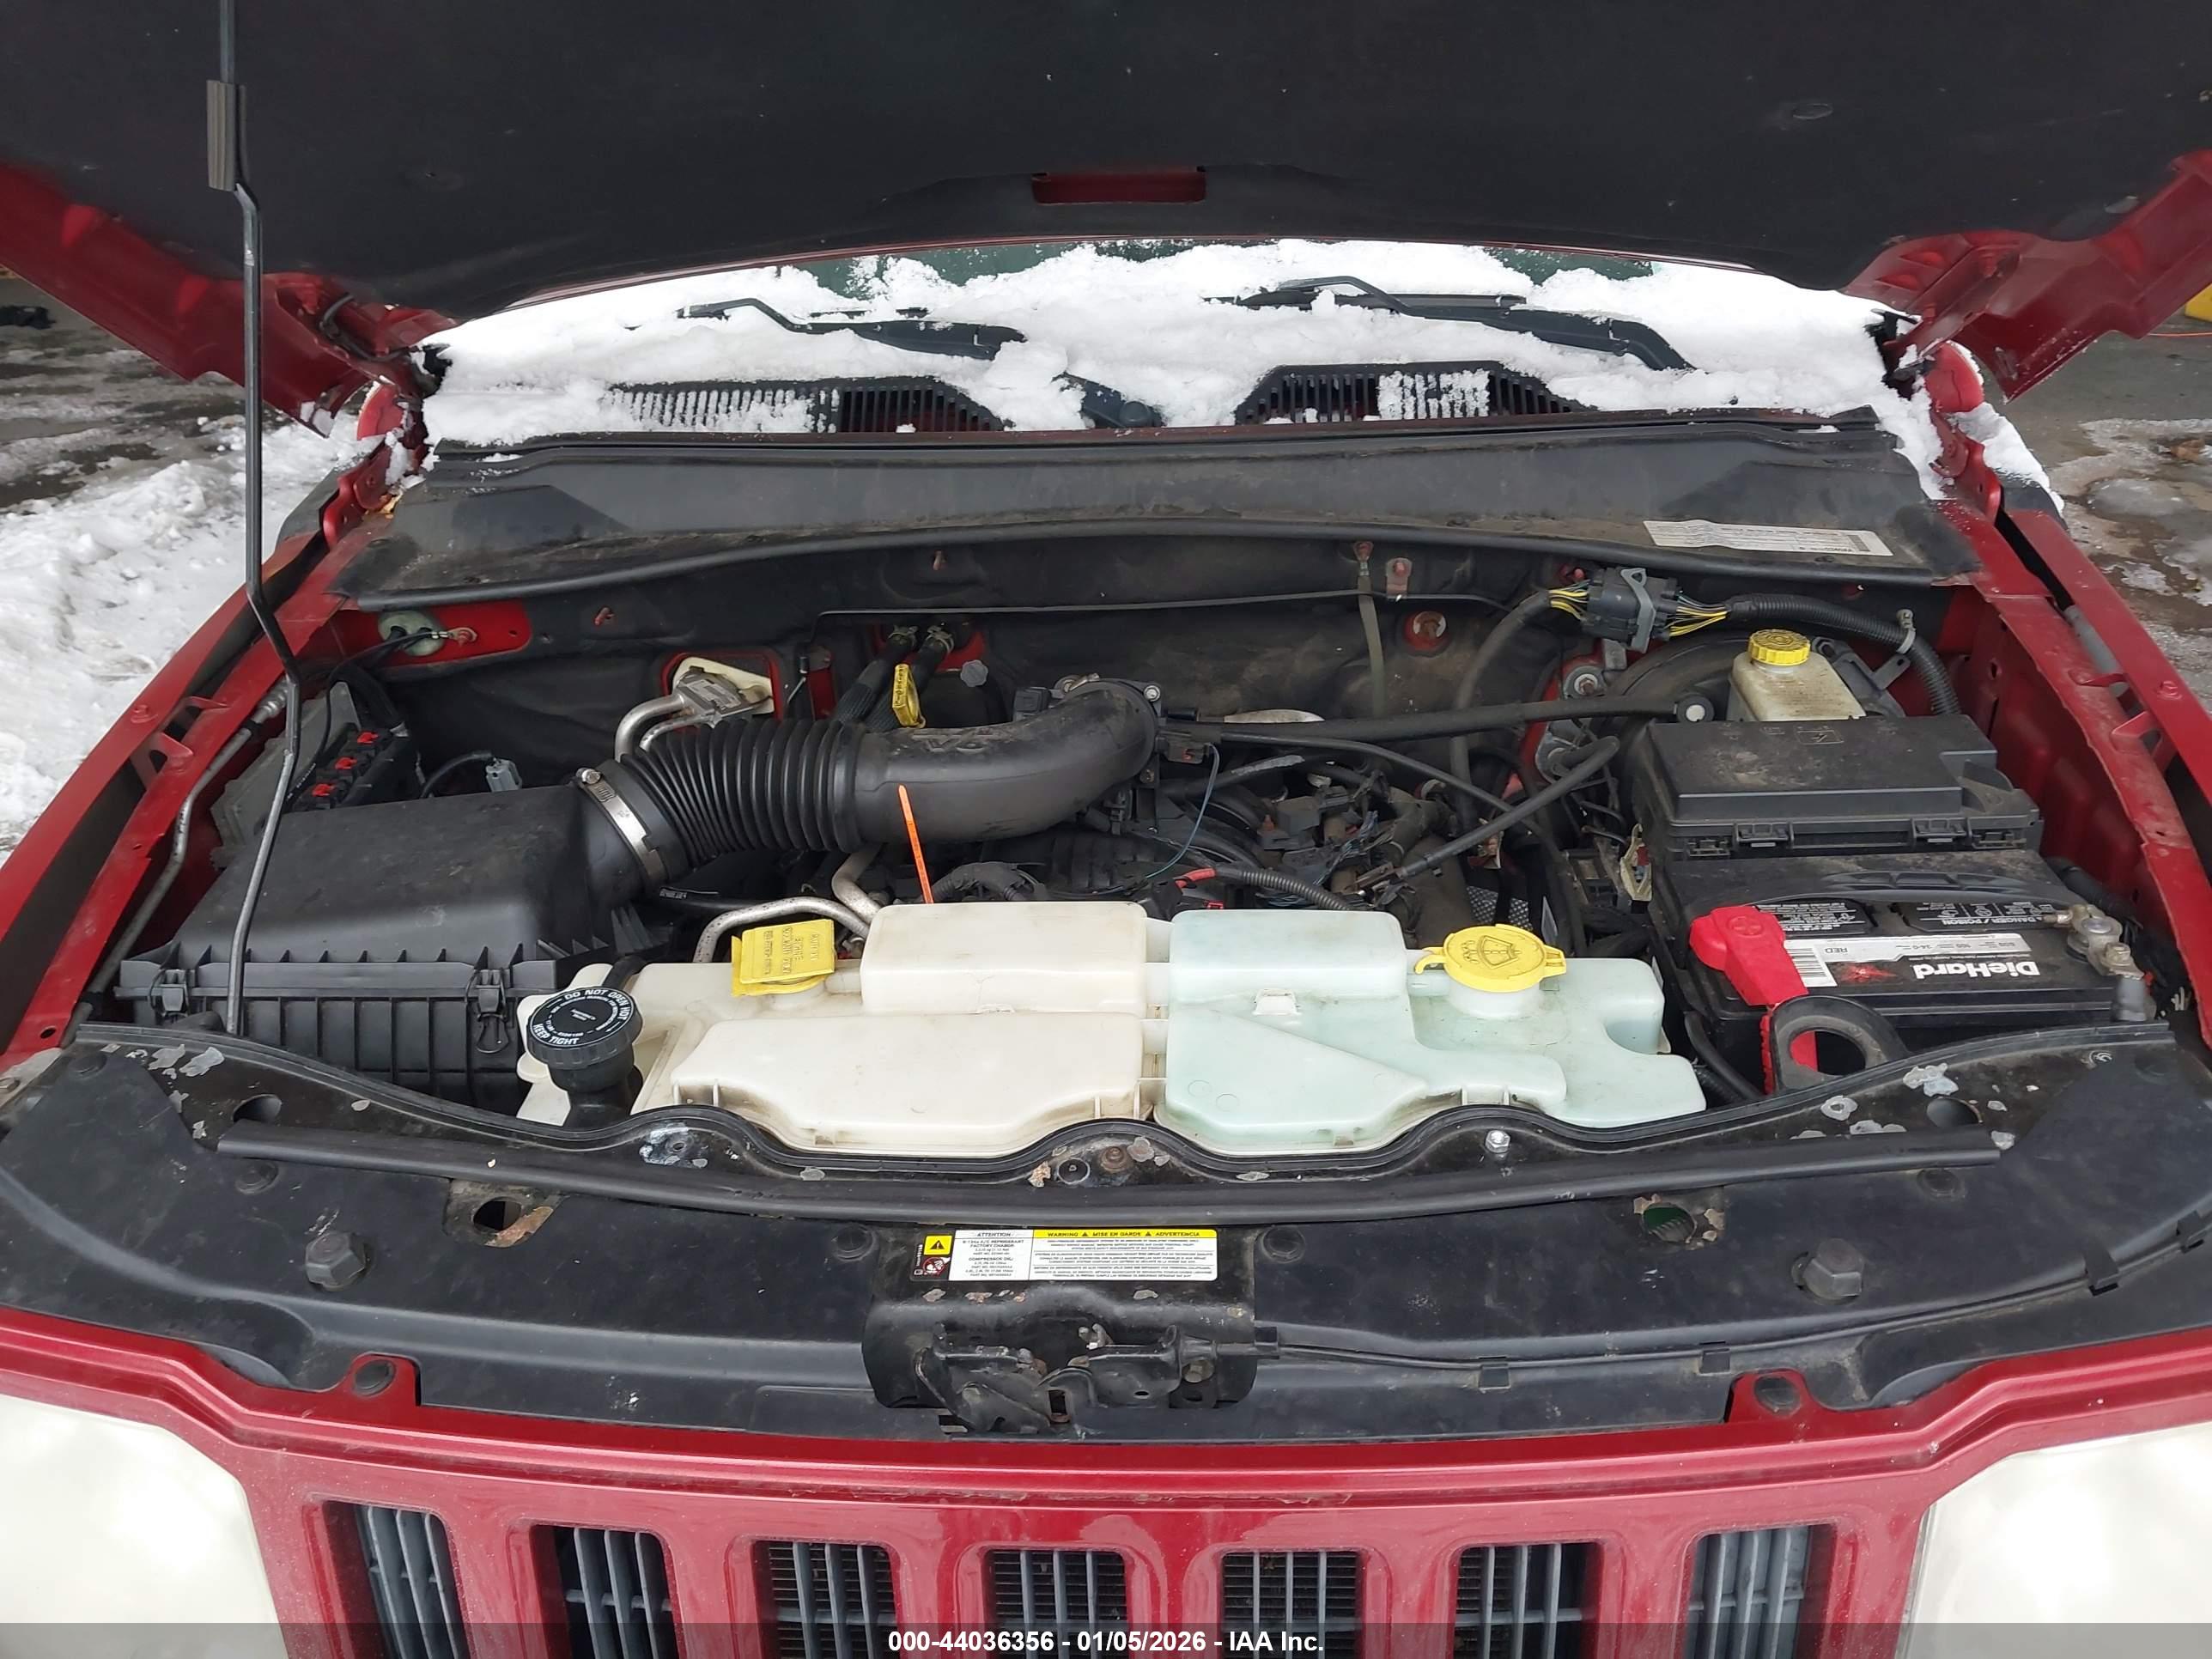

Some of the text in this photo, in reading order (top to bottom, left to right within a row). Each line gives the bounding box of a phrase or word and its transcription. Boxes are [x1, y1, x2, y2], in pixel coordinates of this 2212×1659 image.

[1912, 961, 2041, 980] DieHard
[608, 992, 629, 1007] OPEN
[617, 1006, 631, 1021] HOT
[532, 1024, 550, 1039] KEEP
